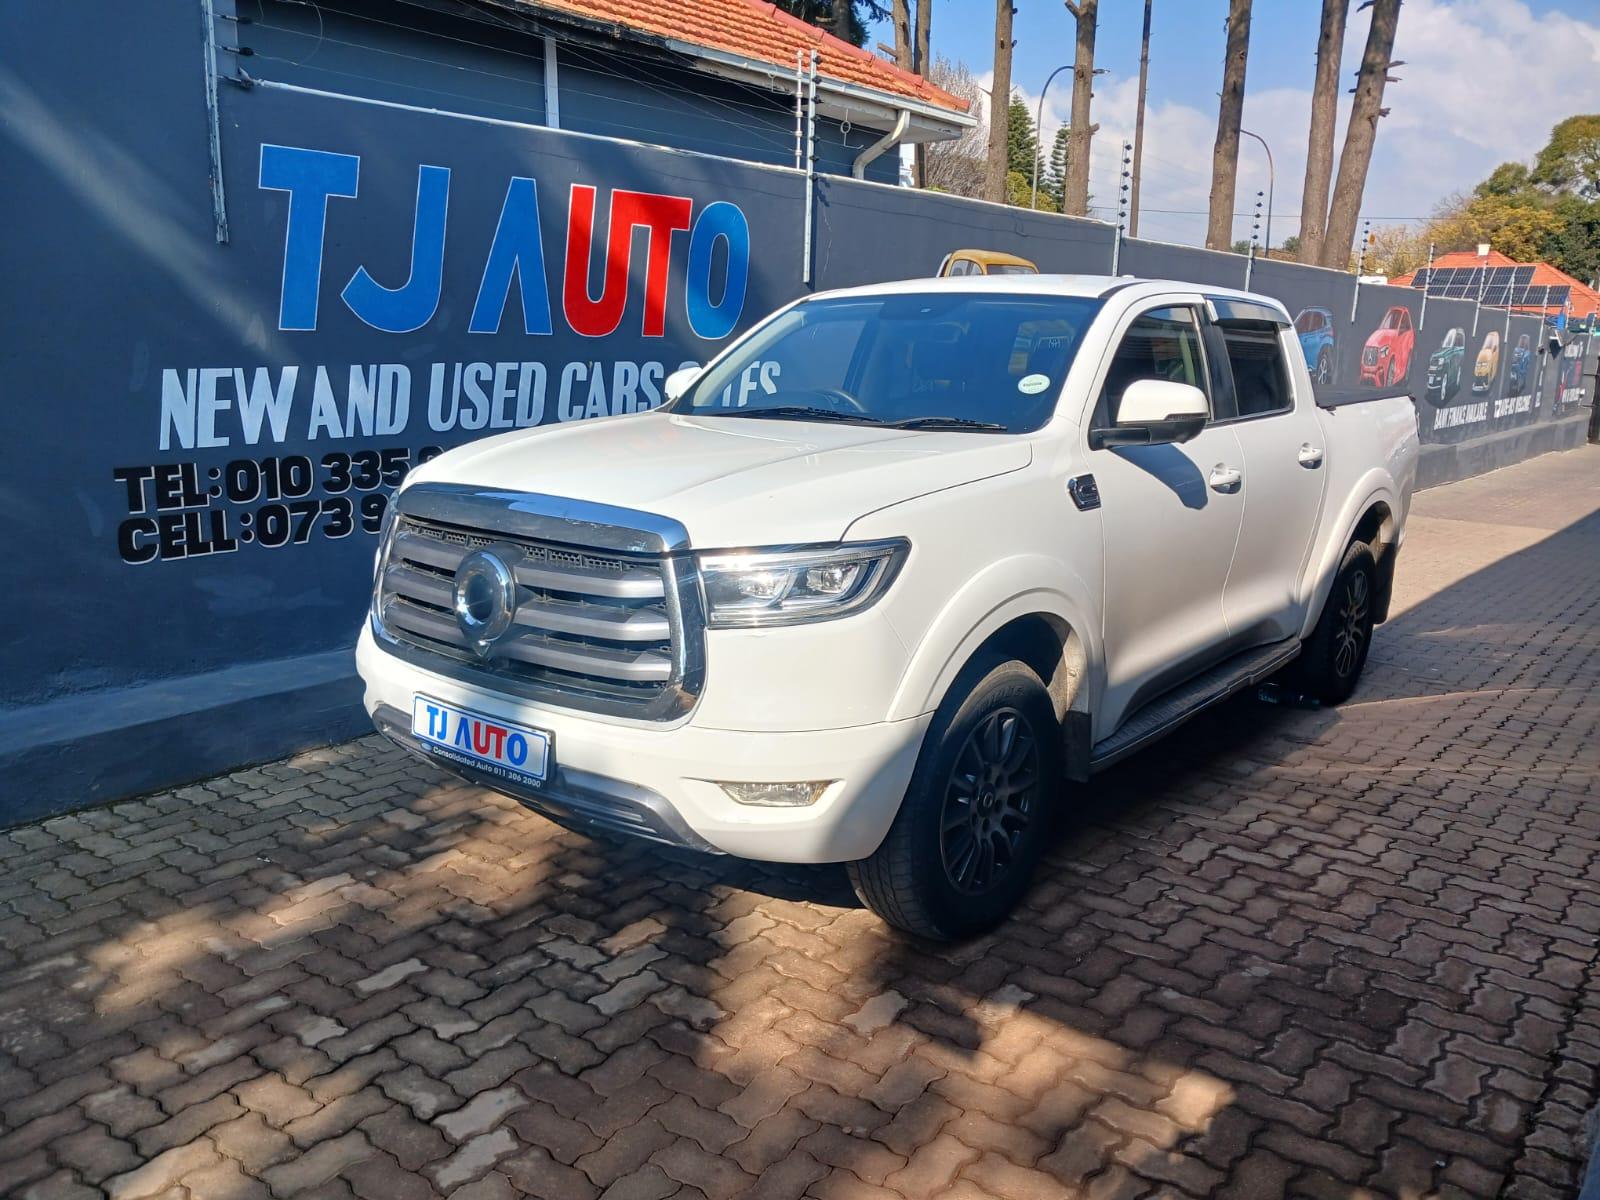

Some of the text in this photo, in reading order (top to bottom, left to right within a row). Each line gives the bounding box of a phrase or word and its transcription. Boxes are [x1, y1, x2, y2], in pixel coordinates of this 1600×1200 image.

[258, 143, 750, 339] TJ AUTO
[159, 365, 299, 450] NEW
[307, 364, 411, 440] AND
[427, 361, 547, 432] USED
[558, 361, 665, 423] CARS
[321, 447, 411, 494] 335
[427, 705, 528, 766] TJ AUTO
[432, 746, 475, 767] Consolidated
[475, 762, 493, 773] Auto
